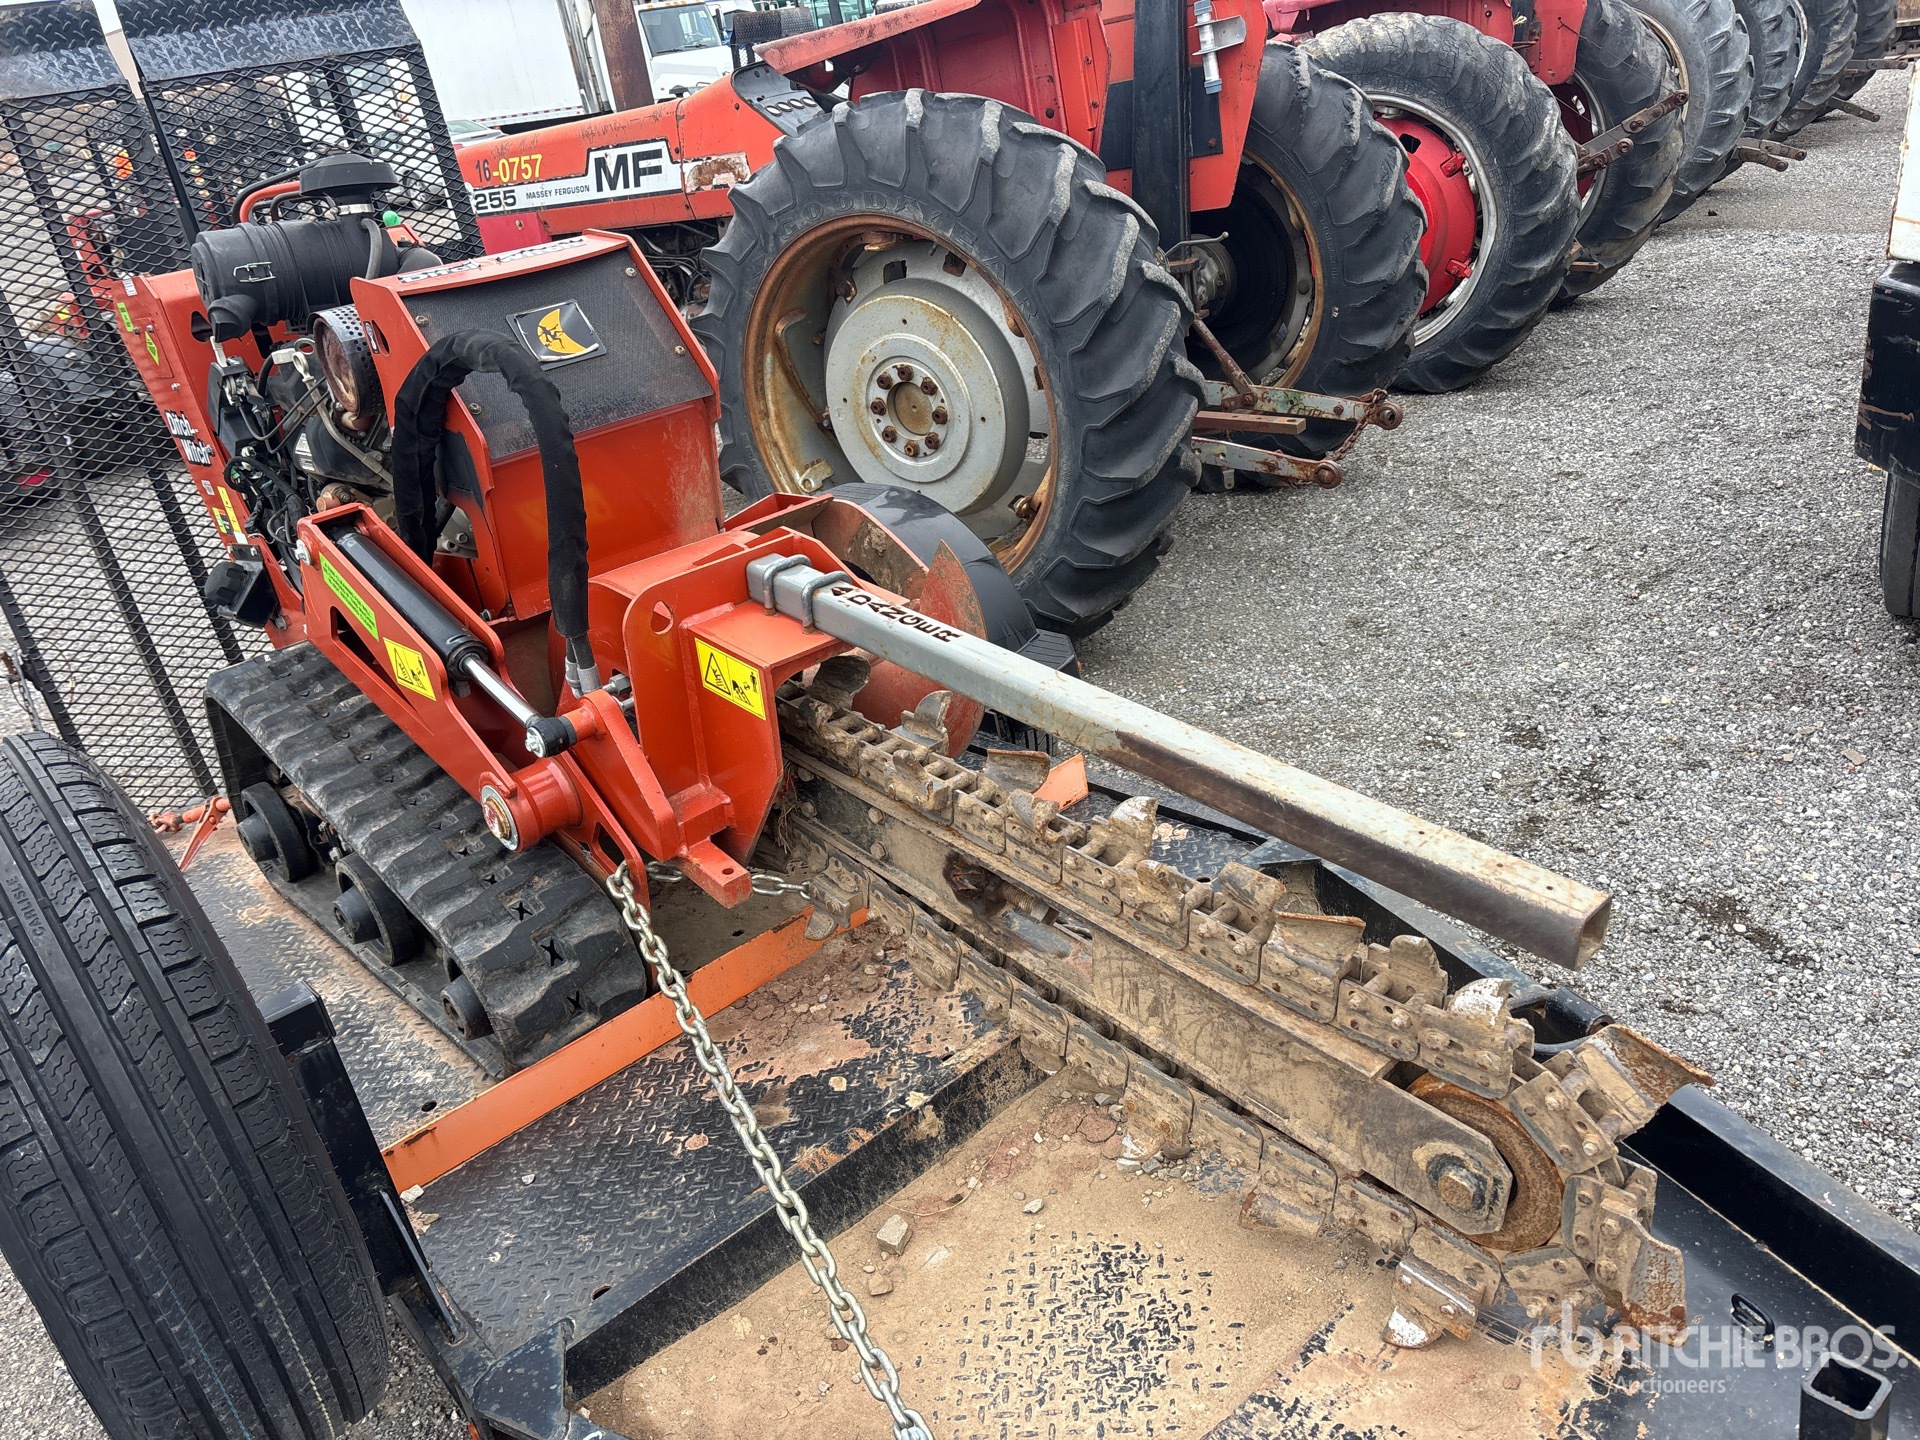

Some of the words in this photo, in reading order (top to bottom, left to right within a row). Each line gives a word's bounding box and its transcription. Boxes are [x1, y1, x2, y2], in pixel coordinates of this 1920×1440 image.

[475, 153, 543, 183] 16-0757
[594, 148, 663, 193] MF
[474, 189, 517, 211] 255
[525, 189, 553, 200] MASSEY
[554, 184, 591, 197] FERGUSON
[779, 190, 1038, 321] GOODYEAR
[165, 409, 194, 437] Ditch
[180, 438, 213, 466] Witch
[849, 594, 962, 643] DANGER
[6, 876, 46, 937] CARLISLE
